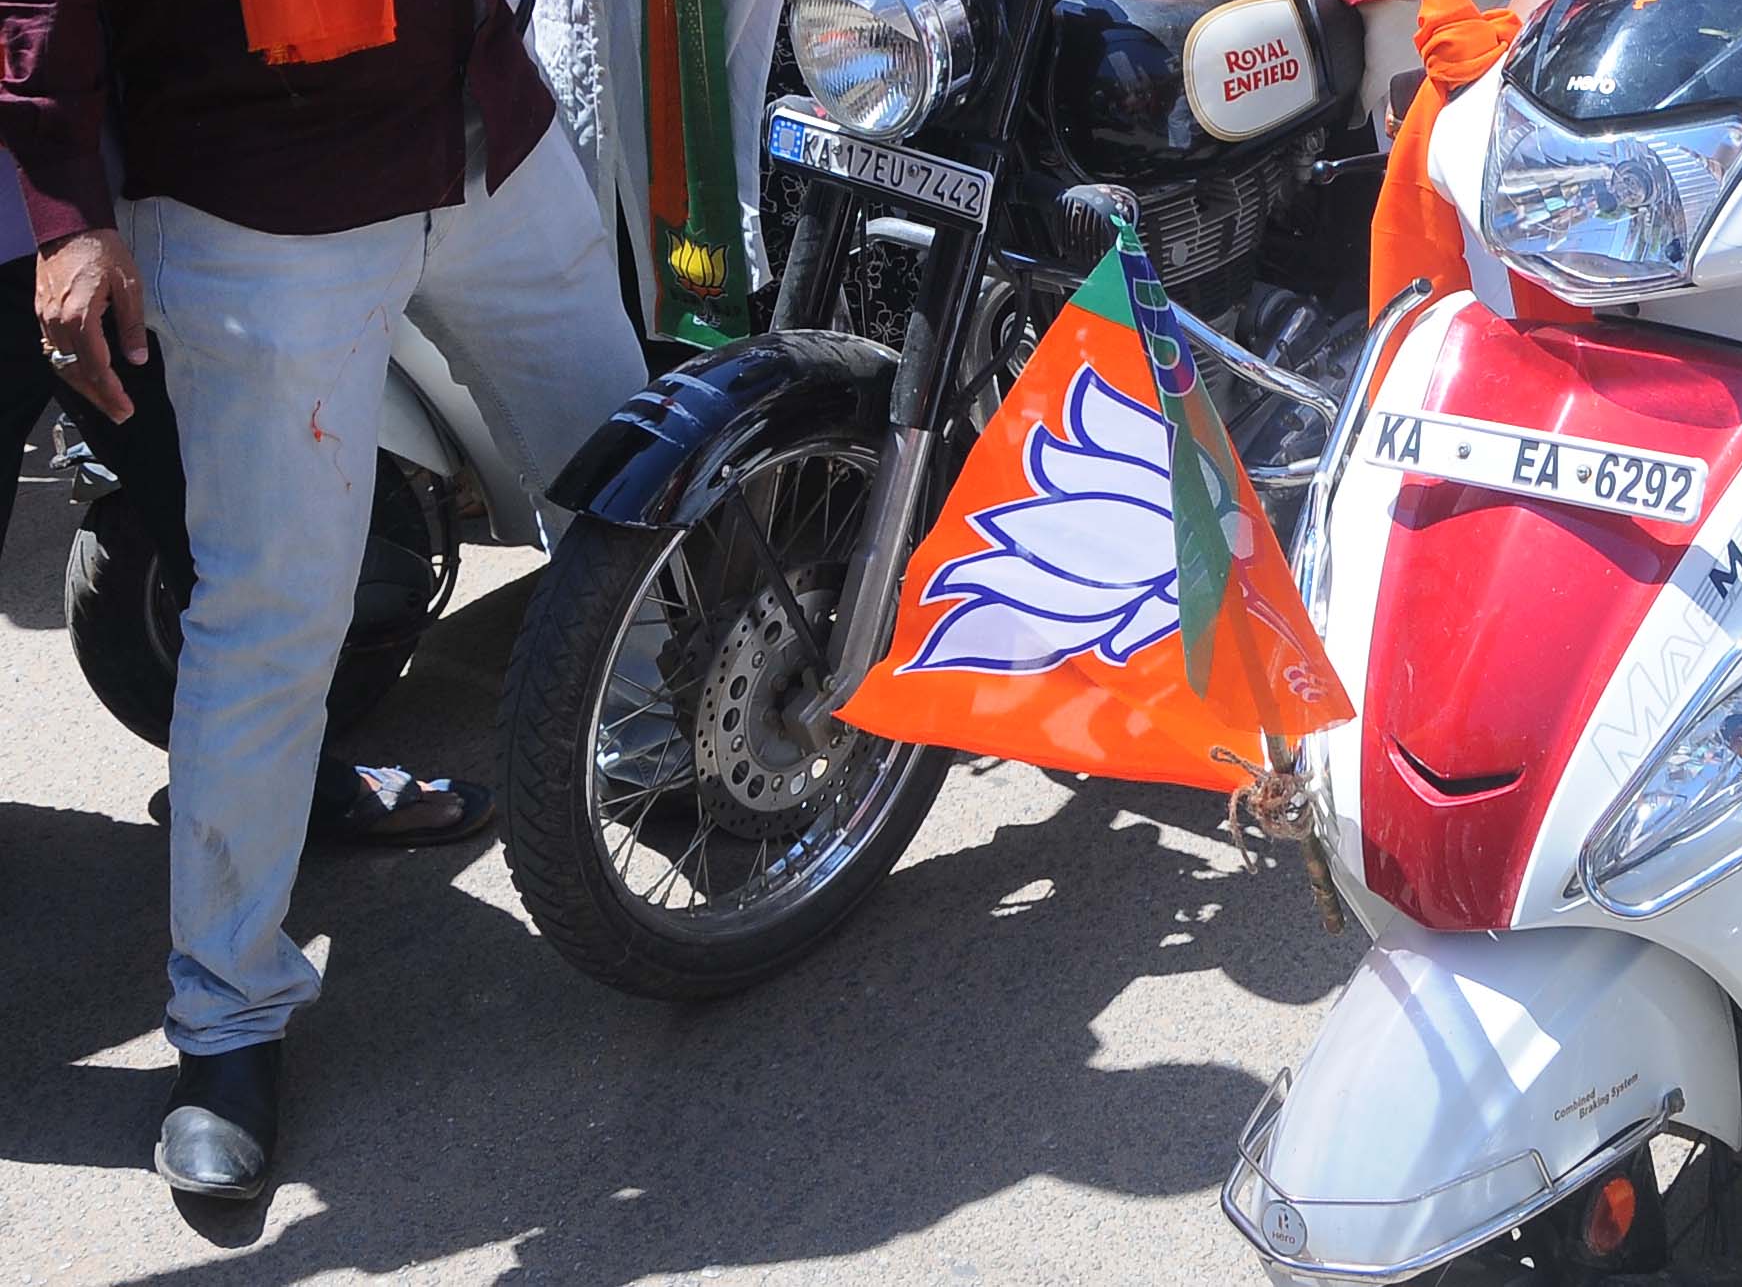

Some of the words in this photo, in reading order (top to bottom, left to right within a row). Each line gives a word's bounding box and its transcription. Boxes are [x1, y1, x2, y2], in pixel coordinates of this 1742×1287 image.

[1224, 38, 1289, 74] ROYAL
[1223, 58, 1299, 102] ENFIELD
[802, 132, 832, 171] KA
[917, 165, 982, 213] 7442
[1374, 414, 1423, 465] KA
[1512, 438, 1560, 491] EA
[1594, 453, 1694, 515] 6292
[1554, 1087, 1596, 1121] Combined
[1579, 1093, 1610, 1119] Braking
[1611, 1073, 1639, 1098] System
[1271, 1230, 1296, 1245] Hero
